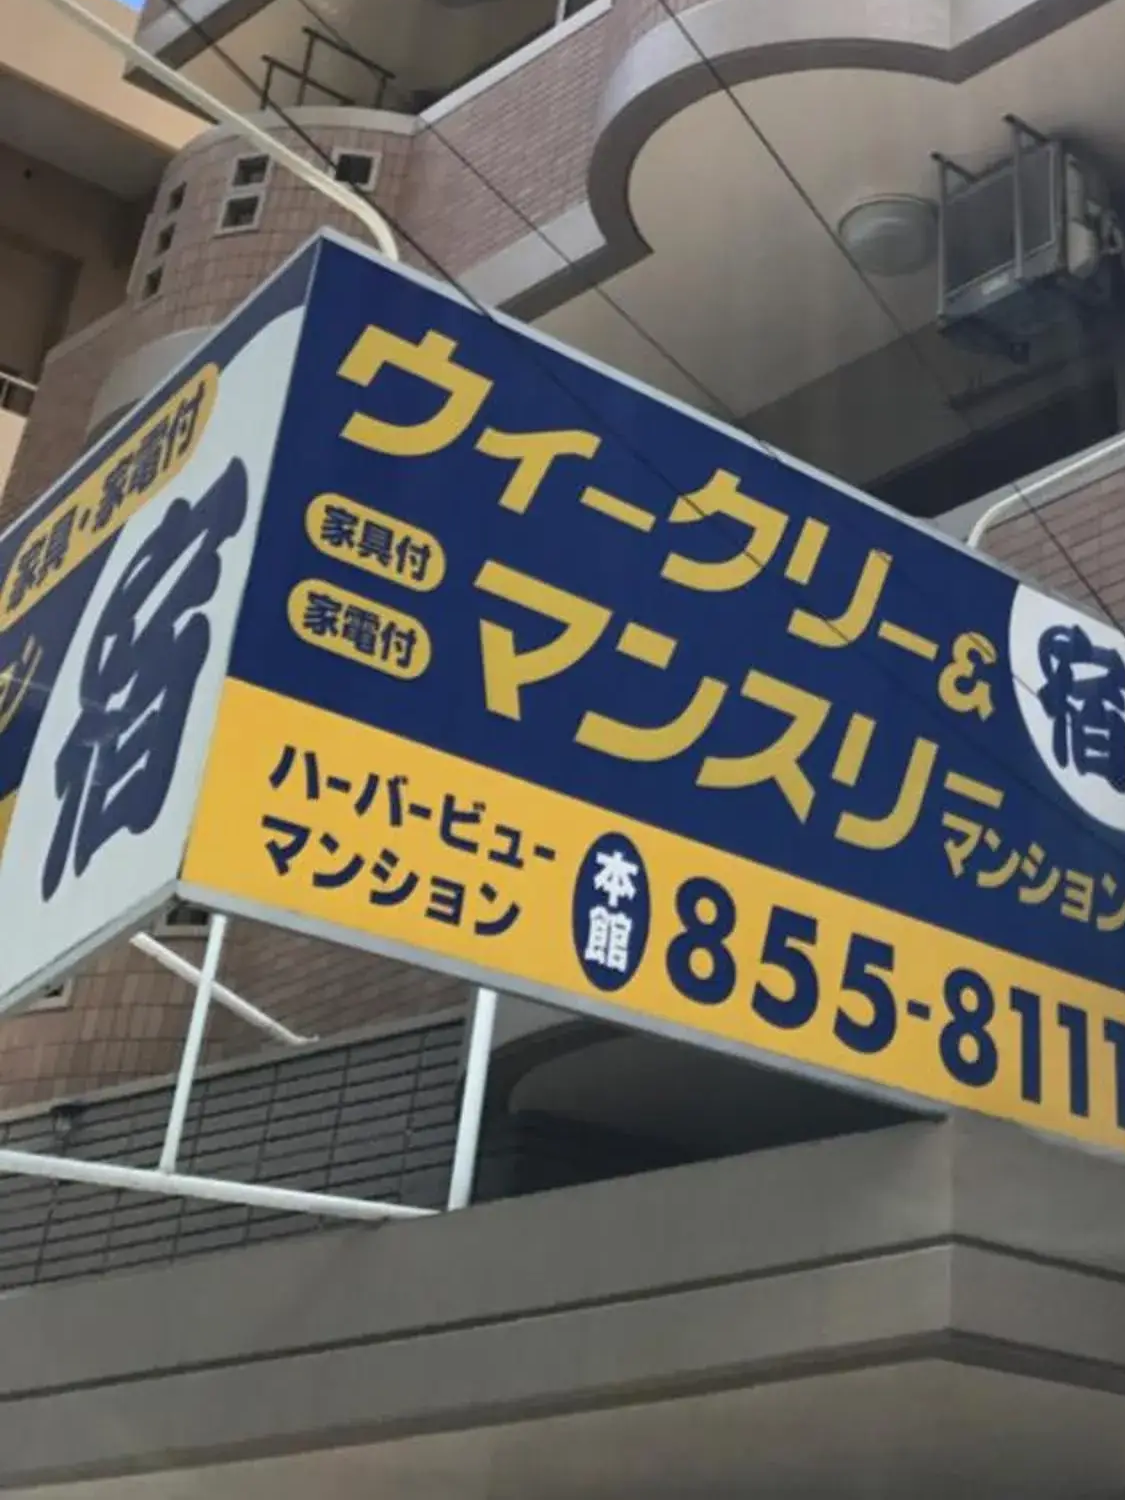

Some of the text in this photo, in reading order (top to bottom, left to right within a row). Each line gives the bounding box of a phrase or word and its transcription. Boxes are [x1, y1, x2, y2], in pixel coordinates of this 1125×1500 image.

[320, 504, 432, 581] 家具付
[303, 591, 416, 669] 家電付
[473, 560, 1004, 851] マンスリー
[268, 745, 556, 869] ハーバービュー
[261, 814, 522, 937] マンション
[584, 850, 639, 973] 本館
